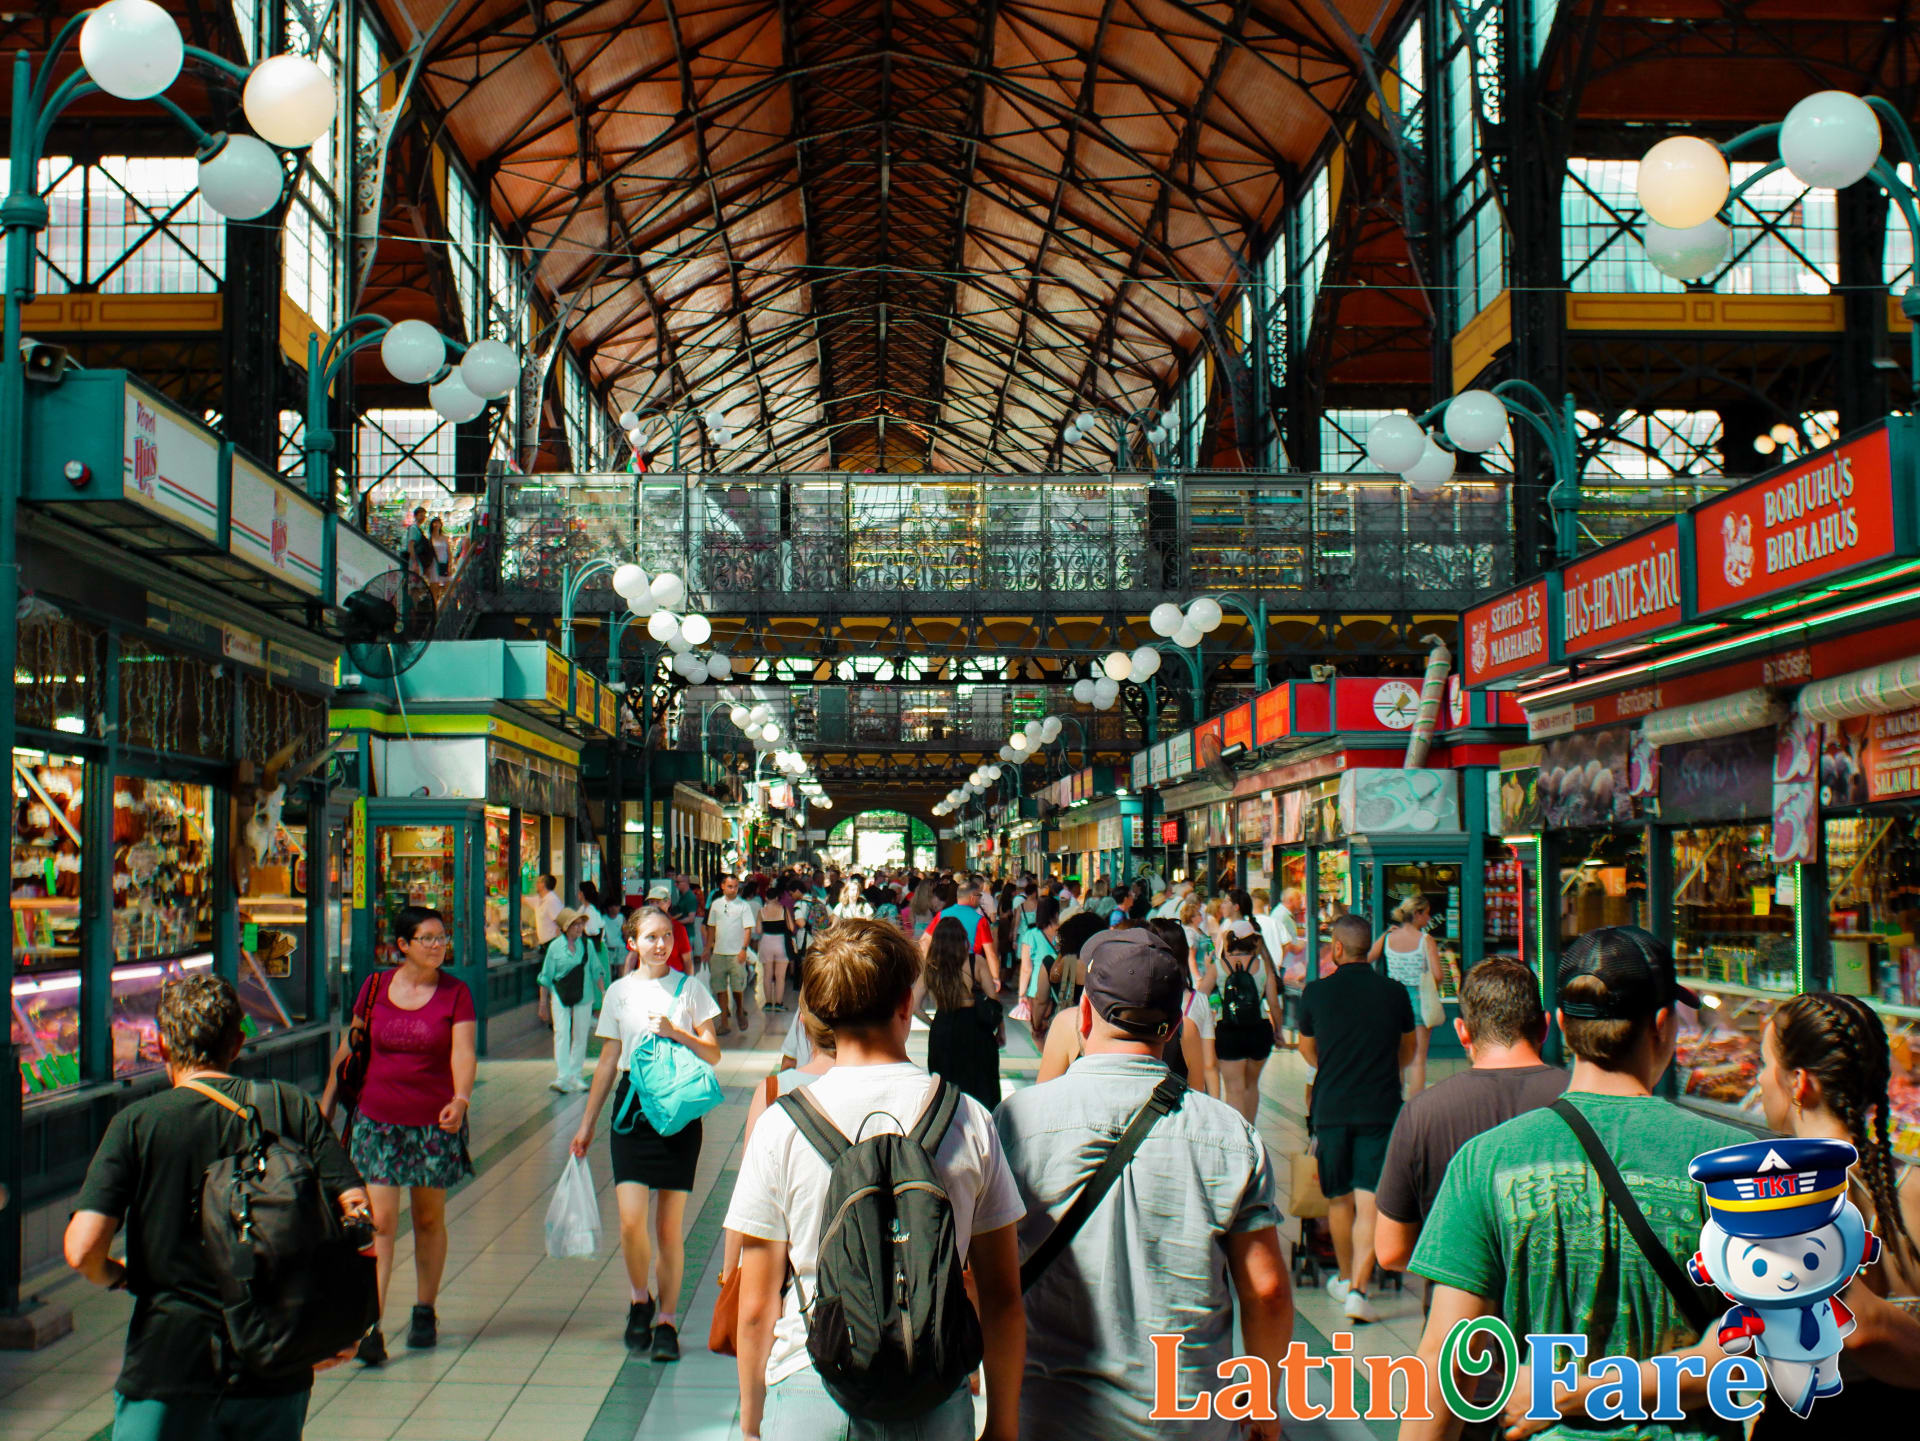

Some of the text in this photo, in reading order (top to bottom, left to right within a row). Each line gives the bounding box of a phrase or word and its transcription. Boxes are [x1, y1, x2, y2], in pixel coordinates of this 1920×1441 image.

[1766, 498, 1858, 573] BIRKAHÚS
[1491, 593, 1525, 633] SERTÉS
[1490, 620, 1543, 666] MARHAHÚS
